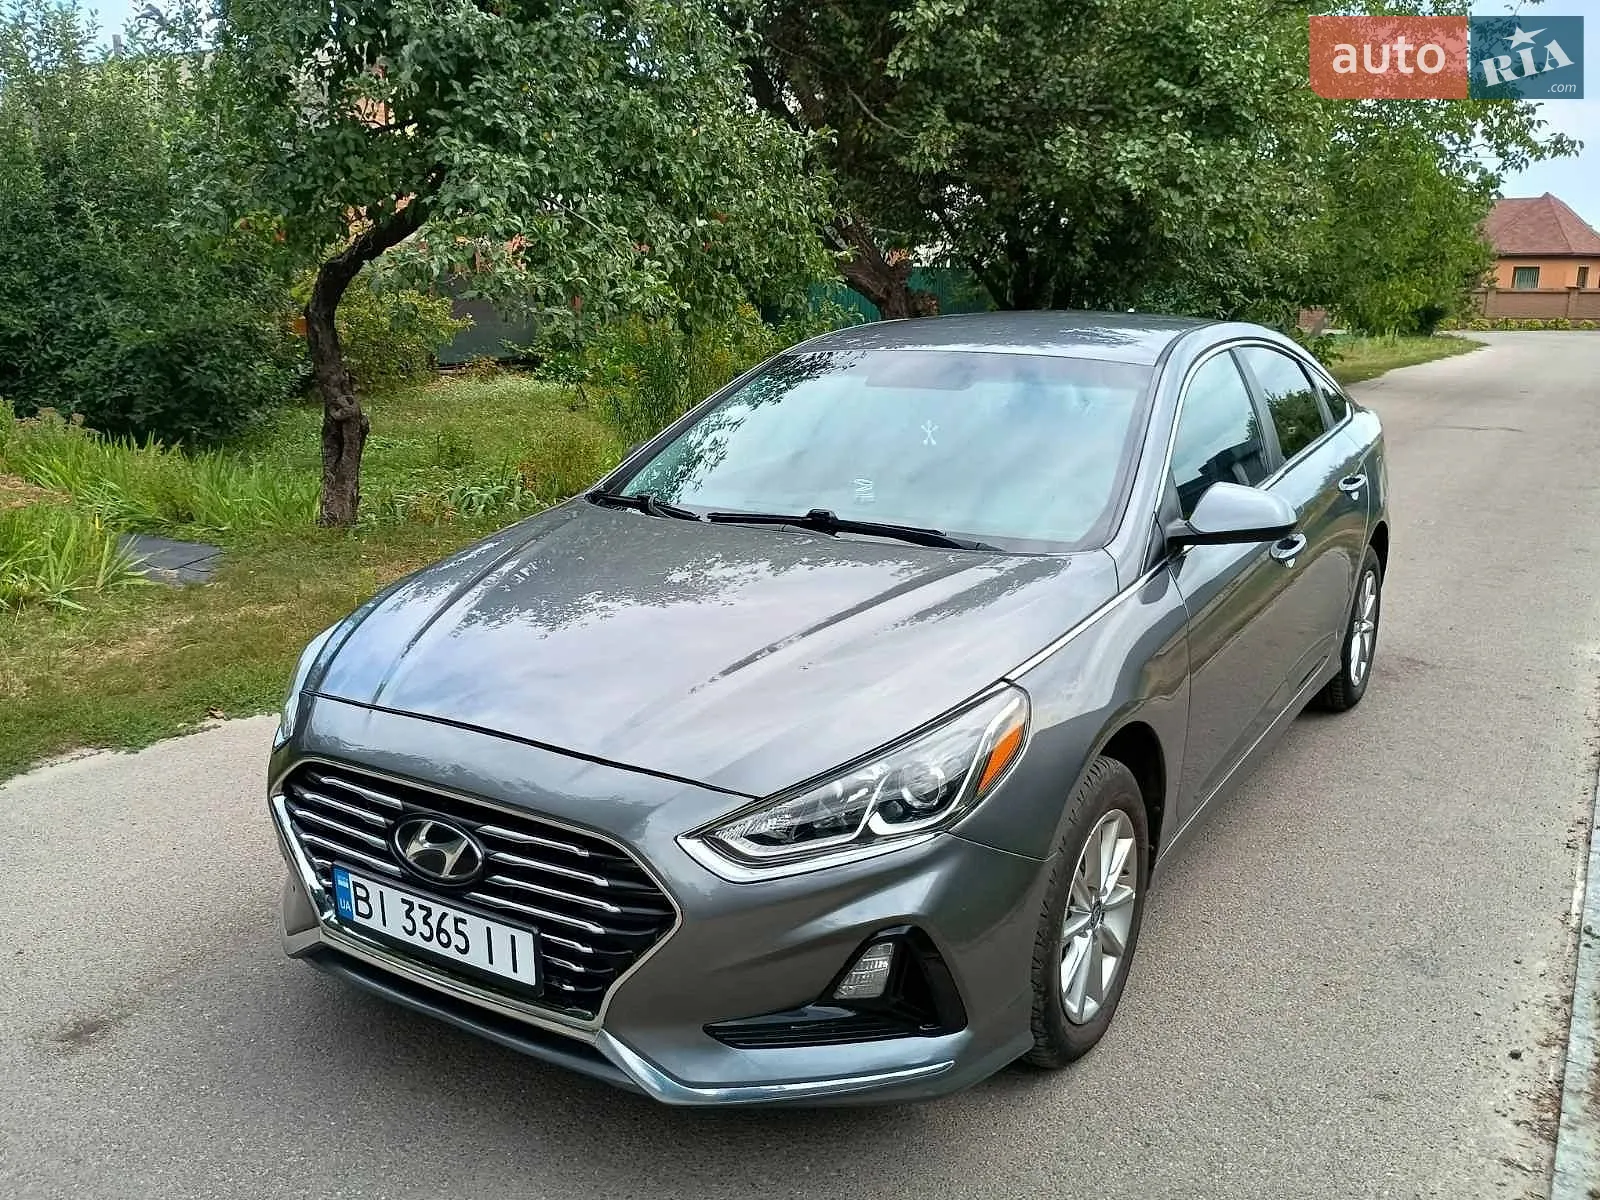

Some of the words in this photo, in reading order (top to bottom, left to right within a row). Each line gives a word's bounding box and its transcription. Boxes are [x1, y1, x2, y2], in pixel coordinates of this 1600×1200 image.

[339, 899, 351, 912] UA
[352, 880, 387, 928] BI
[401, 897, 470, 955] 3365
